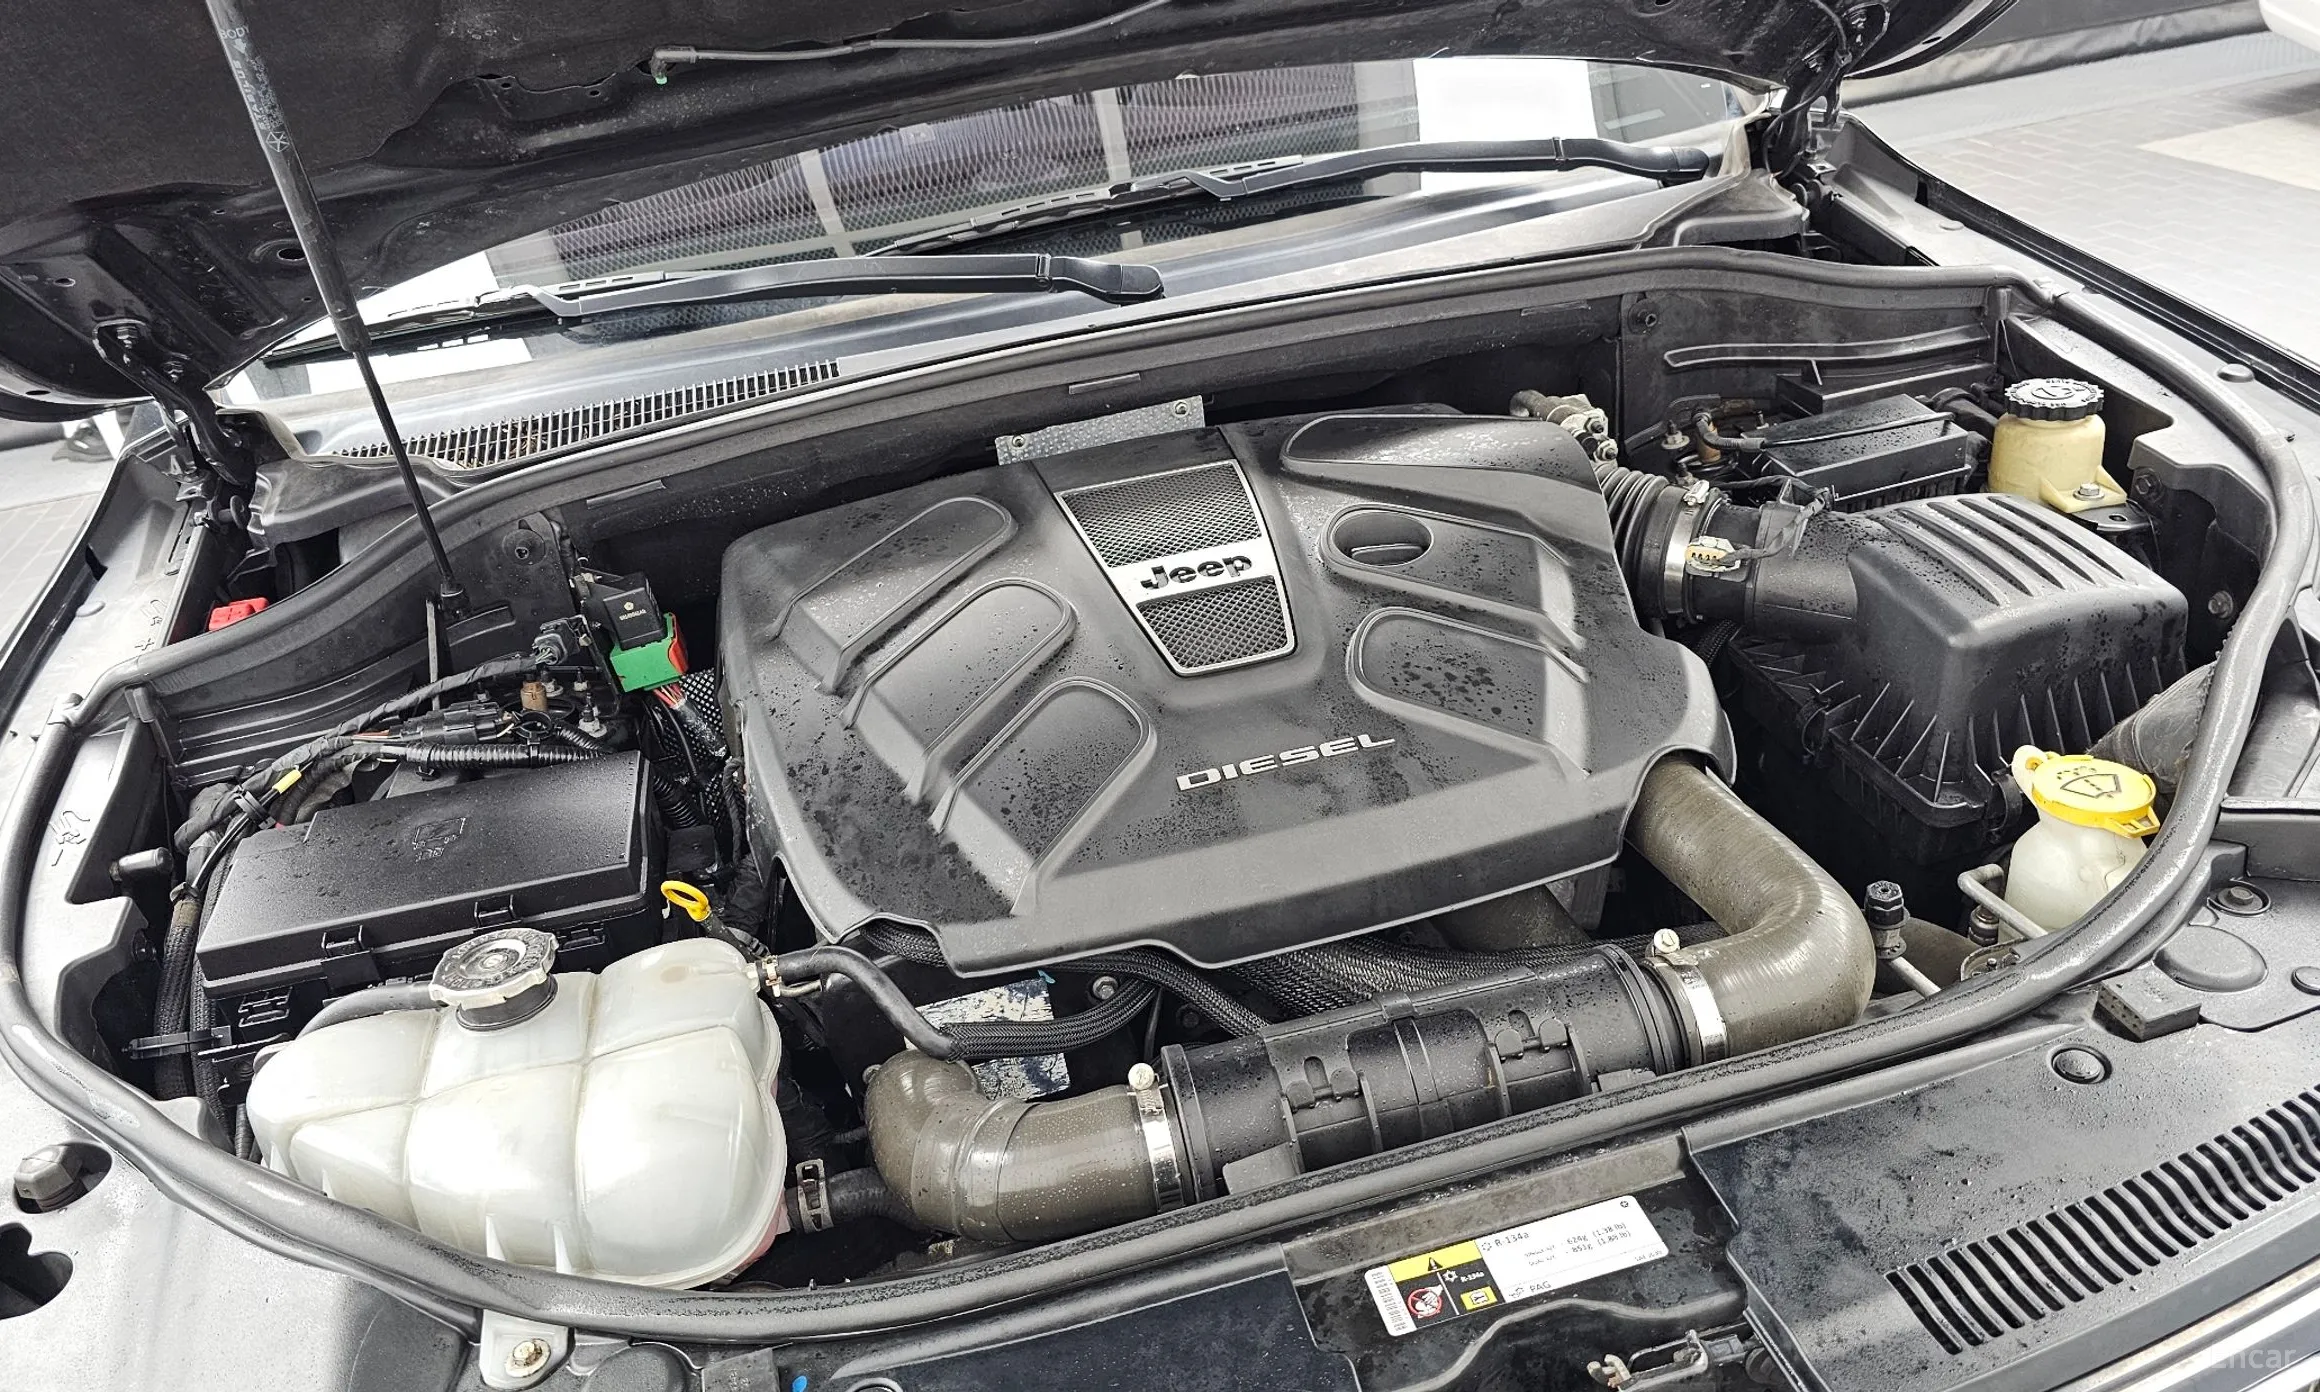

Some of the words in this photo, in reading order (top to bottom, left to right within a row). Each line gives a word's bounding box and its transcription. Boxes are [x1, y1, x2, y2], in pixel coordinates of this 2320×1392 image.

[1140, 555, 1252, 590] Jeep
[1176, 734, 1395, 790] DIESEL
[1494, 1232, 1530, 1247] R-134a
[1529, 1281, 1552, 1293] PAG
